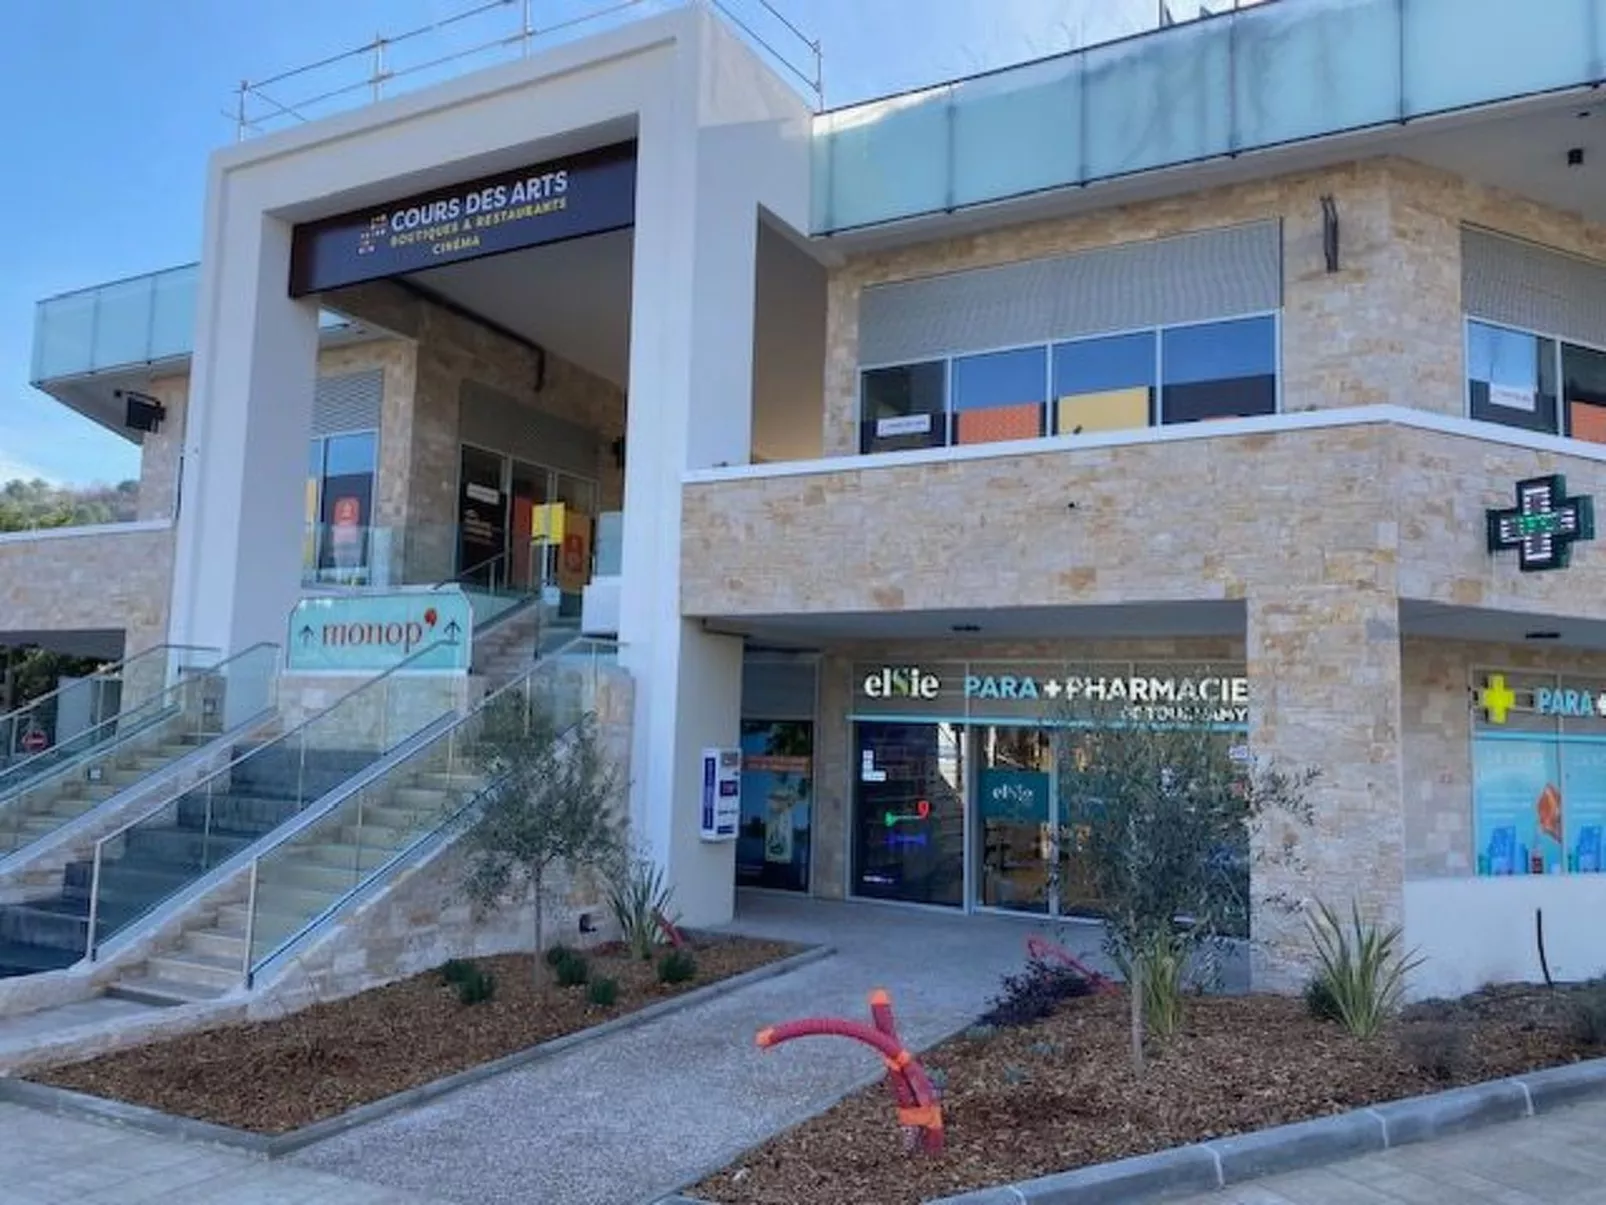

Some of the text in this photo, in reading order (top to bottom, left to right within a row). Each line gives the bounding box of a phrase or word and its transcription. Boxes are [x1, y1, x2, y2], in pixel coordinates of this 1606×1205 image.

[391, 170, 568, 232] COURS DES ARTS
[390, 221, 459, 247] BOUTIQUES
[475, 197, 567, 228] RESTAURANTS
[964, 676, 1039, 699] PARA
[1066, 676, 1249, 701] PHARMACIE
[1537, 687, 1595, 716] PARA
